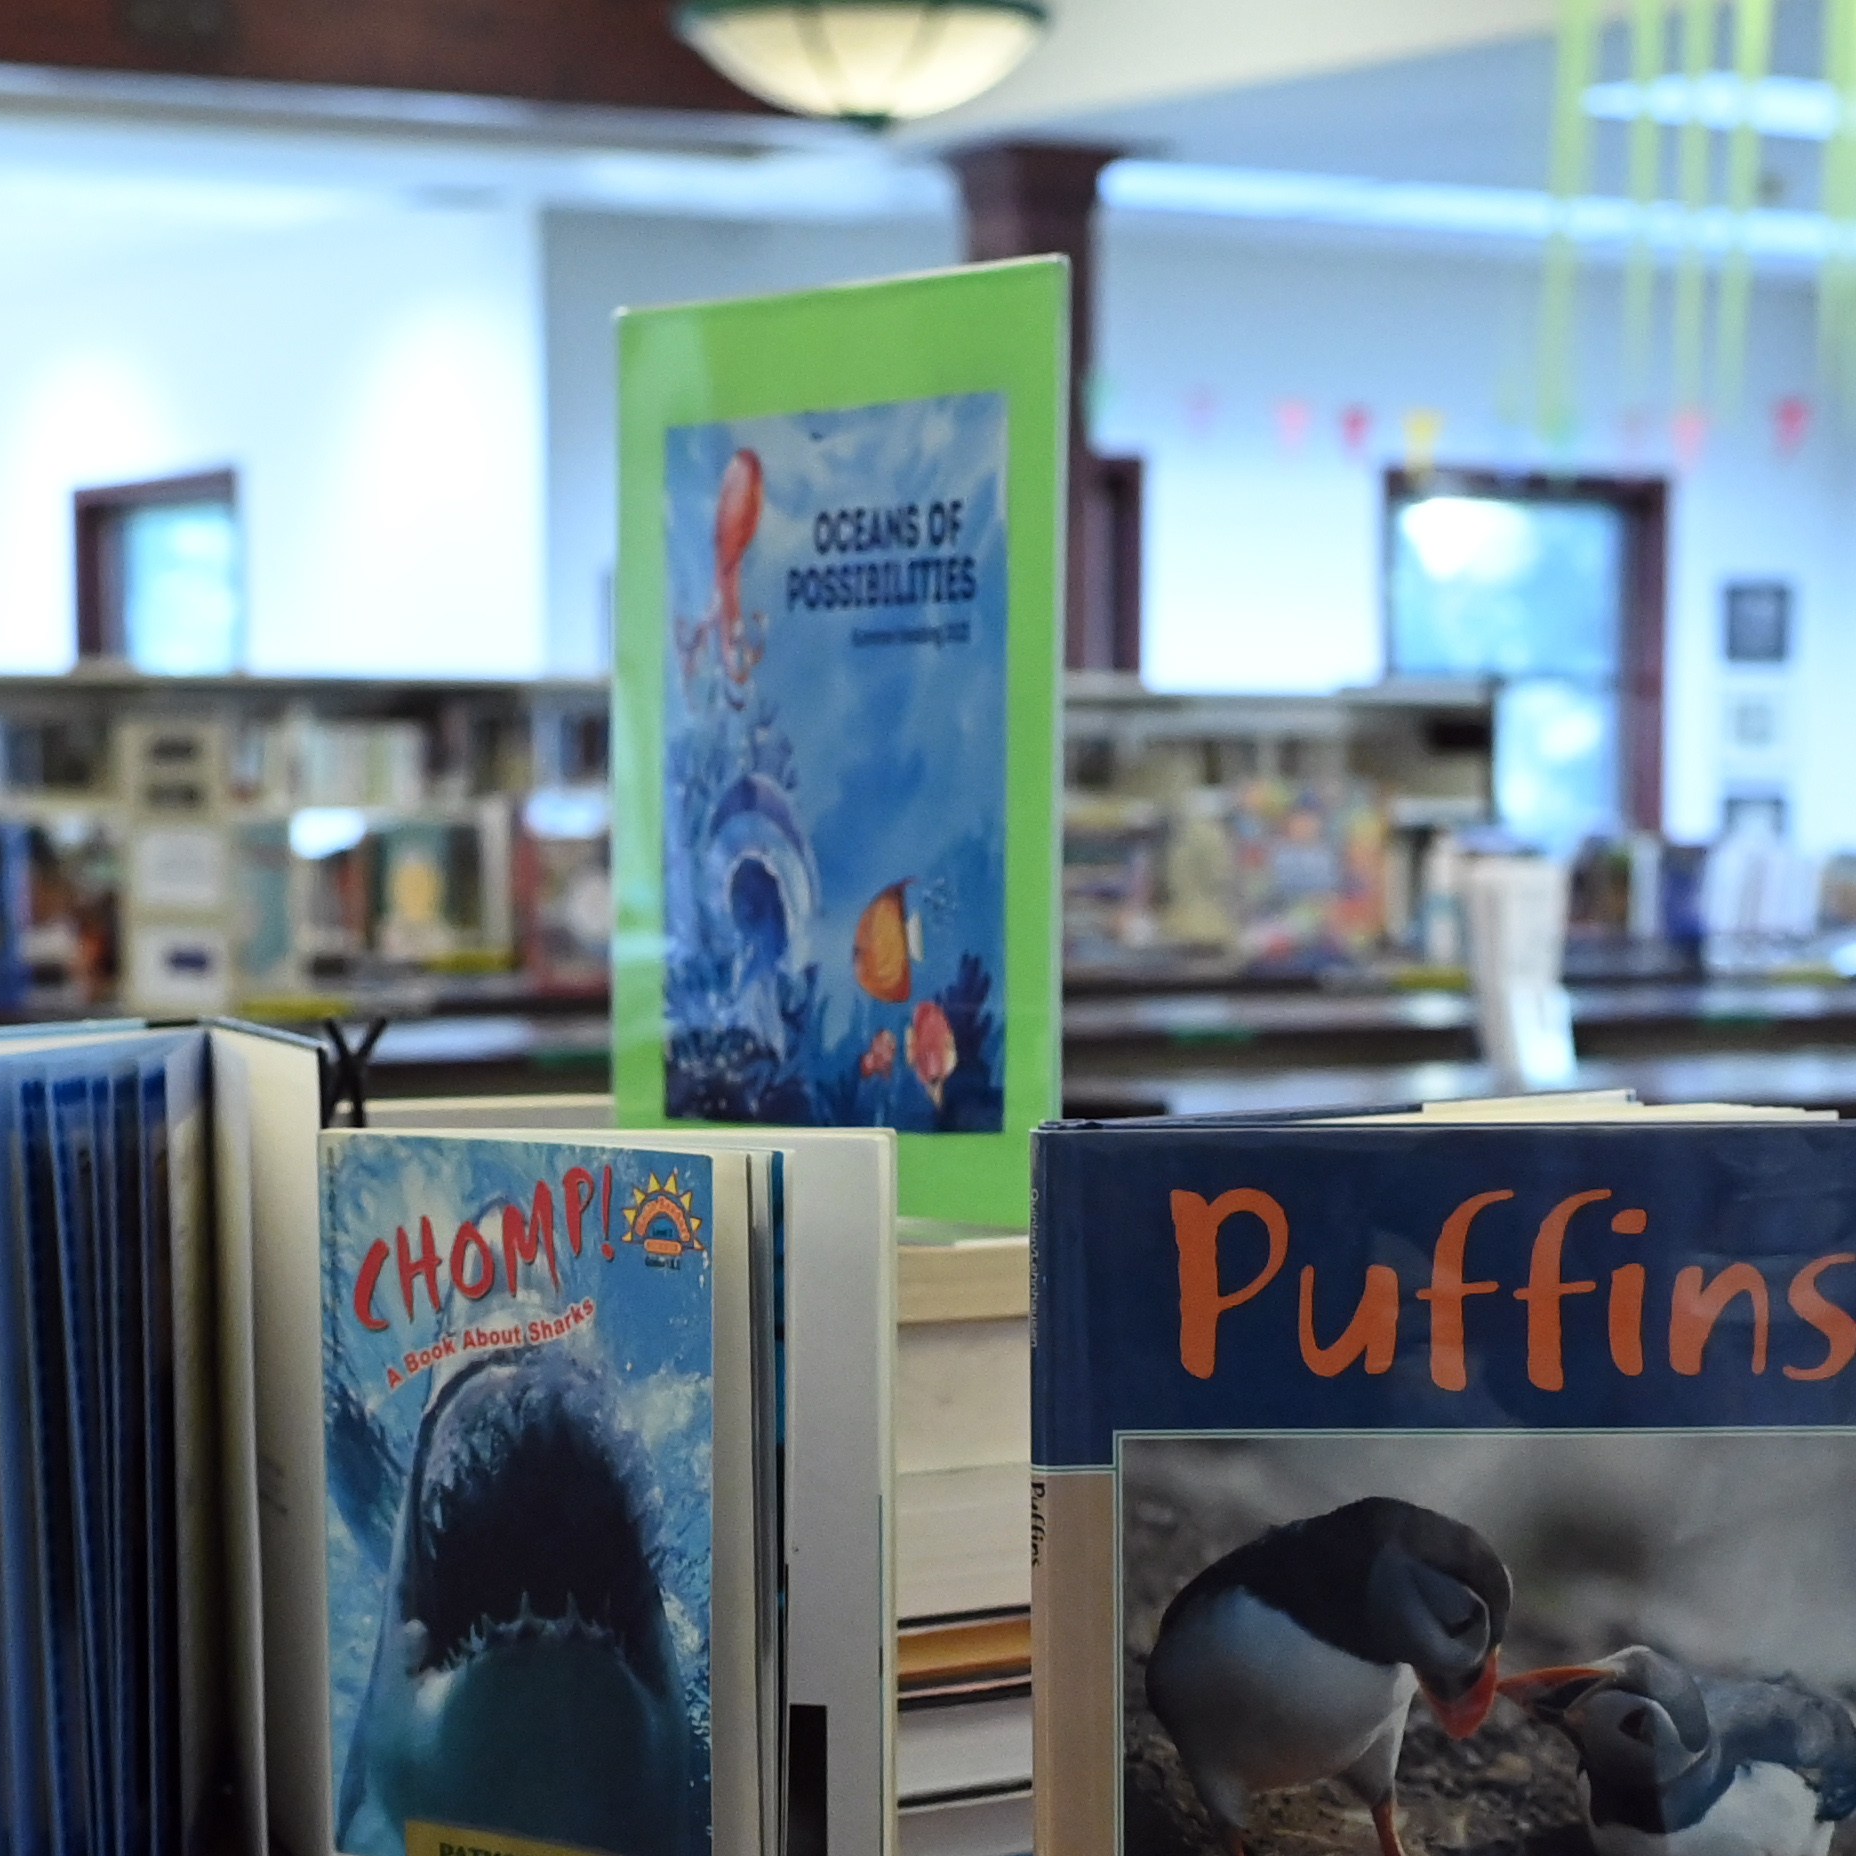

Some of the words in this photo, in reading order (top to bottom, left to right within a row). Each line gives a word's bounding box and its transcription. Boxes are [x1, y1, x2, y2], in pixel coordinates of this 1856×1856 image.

[815, 503, 920, 556] OCEANS
[929, 498, 964, 548] OF
[786, 555, 977, 613] POSSIBILITIES
[353, 1164, 615, 1332] CHOMP!
[386, 1366, 403, 1390] A
[402, 1336, 456, 1374] Book
[463, 1325, 523, 1351] About
[530, 1297, 595, 1343] Sharks
